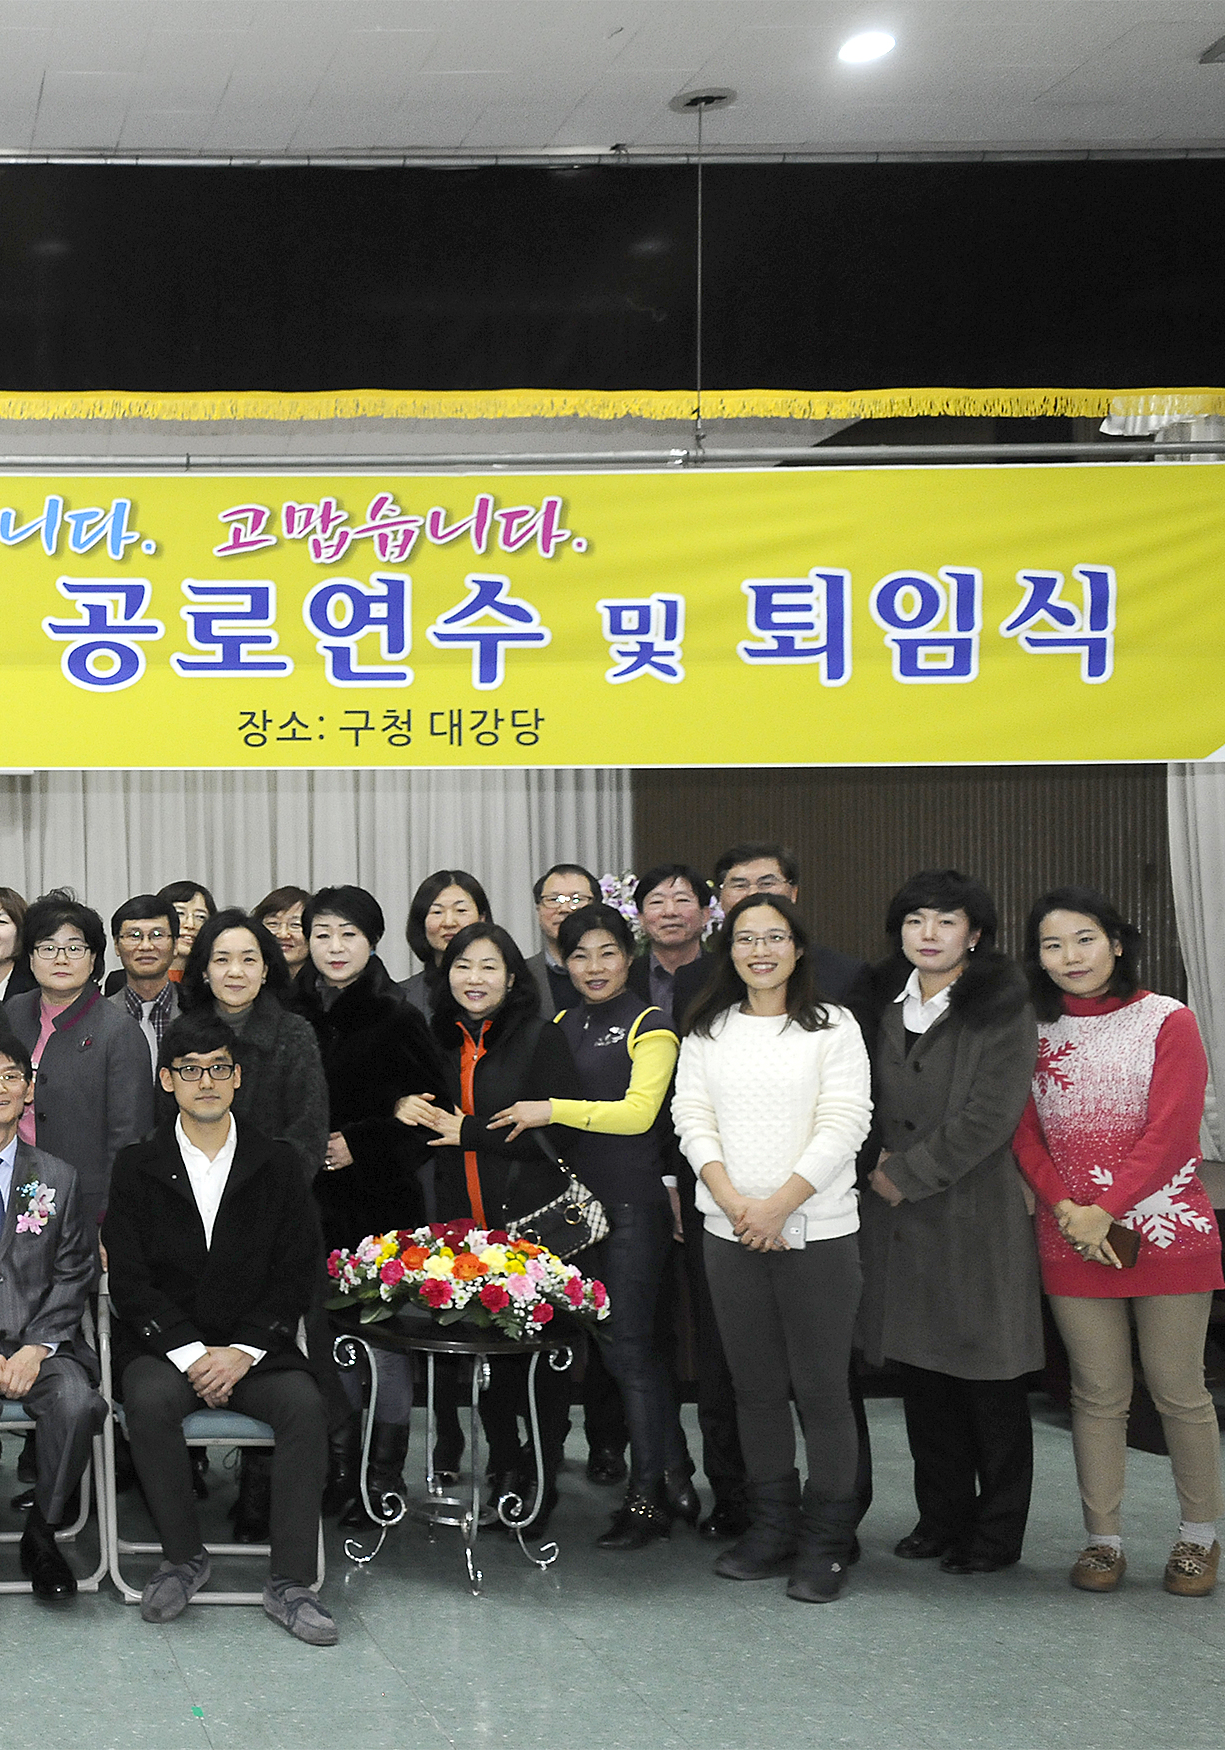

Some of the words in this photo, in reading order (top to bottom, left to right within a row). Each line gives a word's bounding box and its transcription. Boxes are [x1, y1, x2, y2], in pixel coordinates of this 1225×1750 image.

[217, 495, 584, 561] 고맙습니다.
[47, 576, 547, 688] 공로연수
[603, 597, 680, 679] 및
[742, 569, 1111, 682] 퇴임식
[238, 708, 326, 748] 장소:
[339, 708, 413, 748] 구청
[430, 708, 546, 748] 대강당
